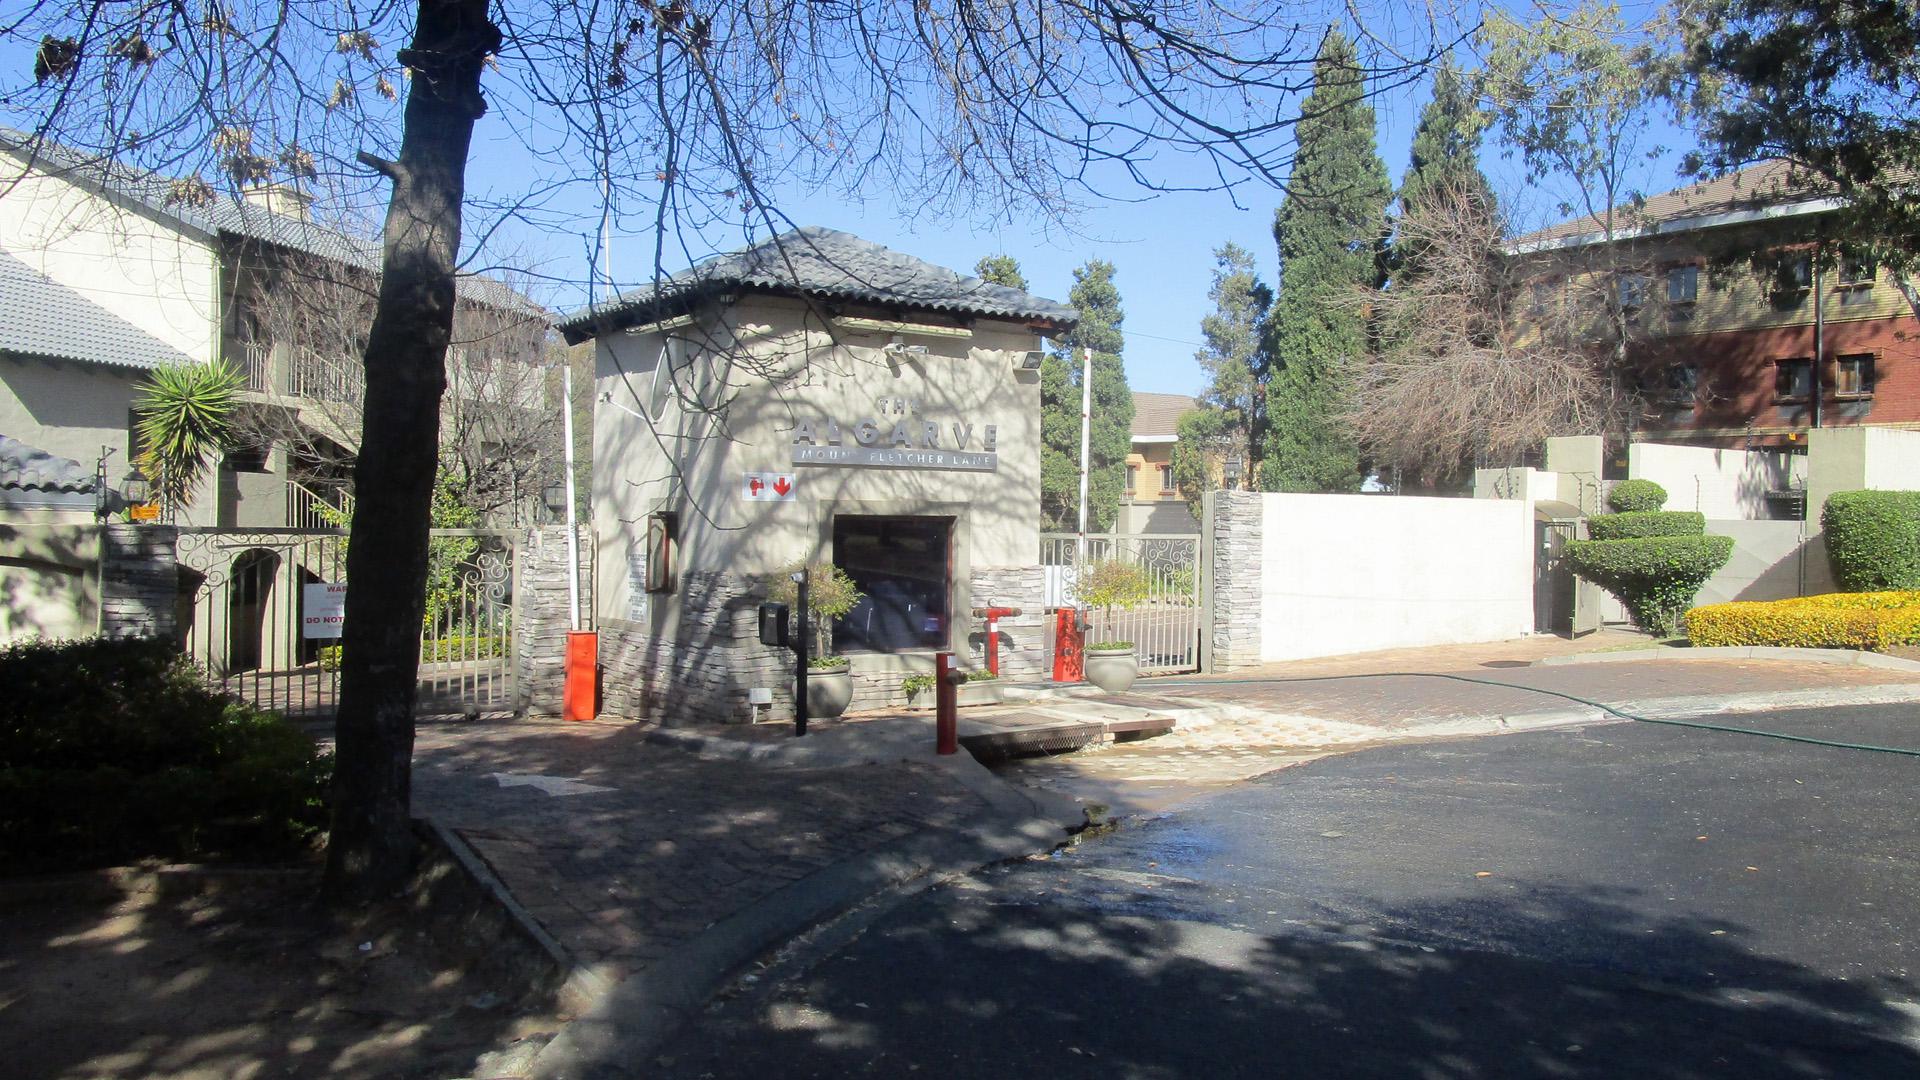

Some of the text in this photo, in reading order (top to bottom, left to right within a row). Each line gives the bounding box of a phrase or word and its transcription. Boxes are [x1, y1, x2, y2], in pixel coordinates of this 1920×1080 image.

[879, 398, 921, 416] THE
[793, 415, 998, 452] ALGARVE
[870, 452, 944, 464] FLETCHER
[953, 455, 990, 465] LANE
